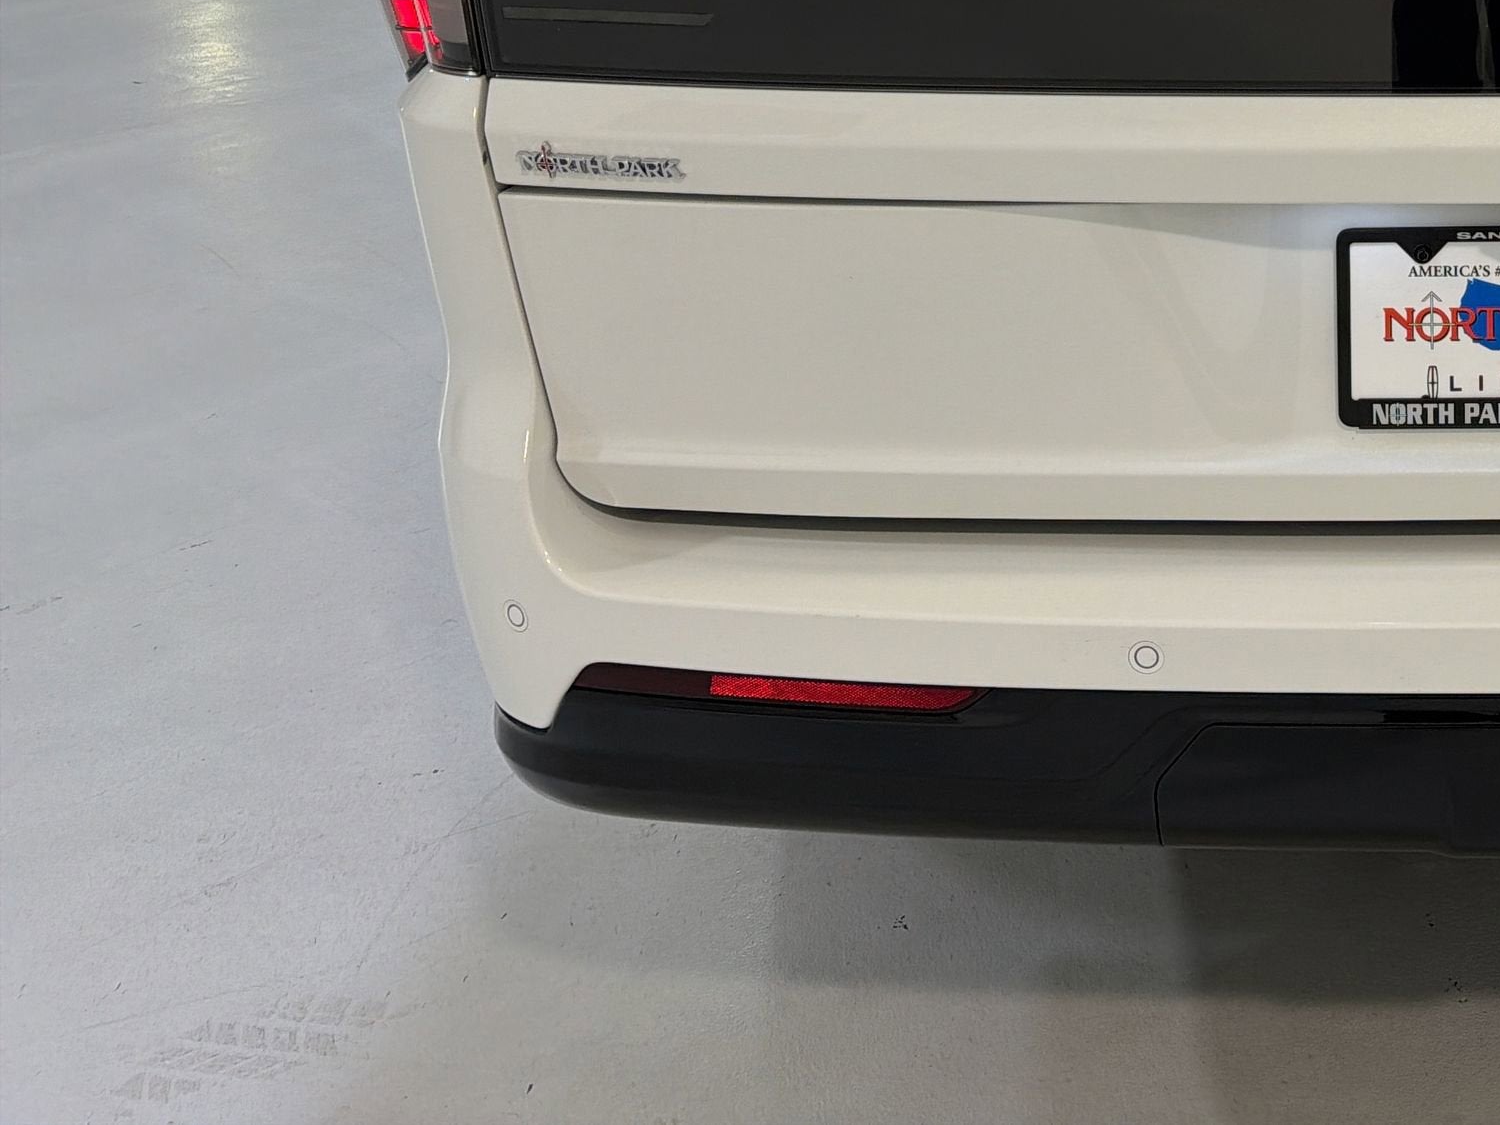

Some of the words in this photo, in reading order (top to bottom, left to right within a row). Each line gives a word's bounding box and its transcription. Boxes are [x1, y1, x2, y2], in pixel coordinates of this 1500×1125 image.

[517, 150, 610, 177] NORTH
[612, 156, 686, 179] PARK
[1408, 265, 1491, 277] AMERICA'S
[1372, 403, 1455, 426] NORTH
